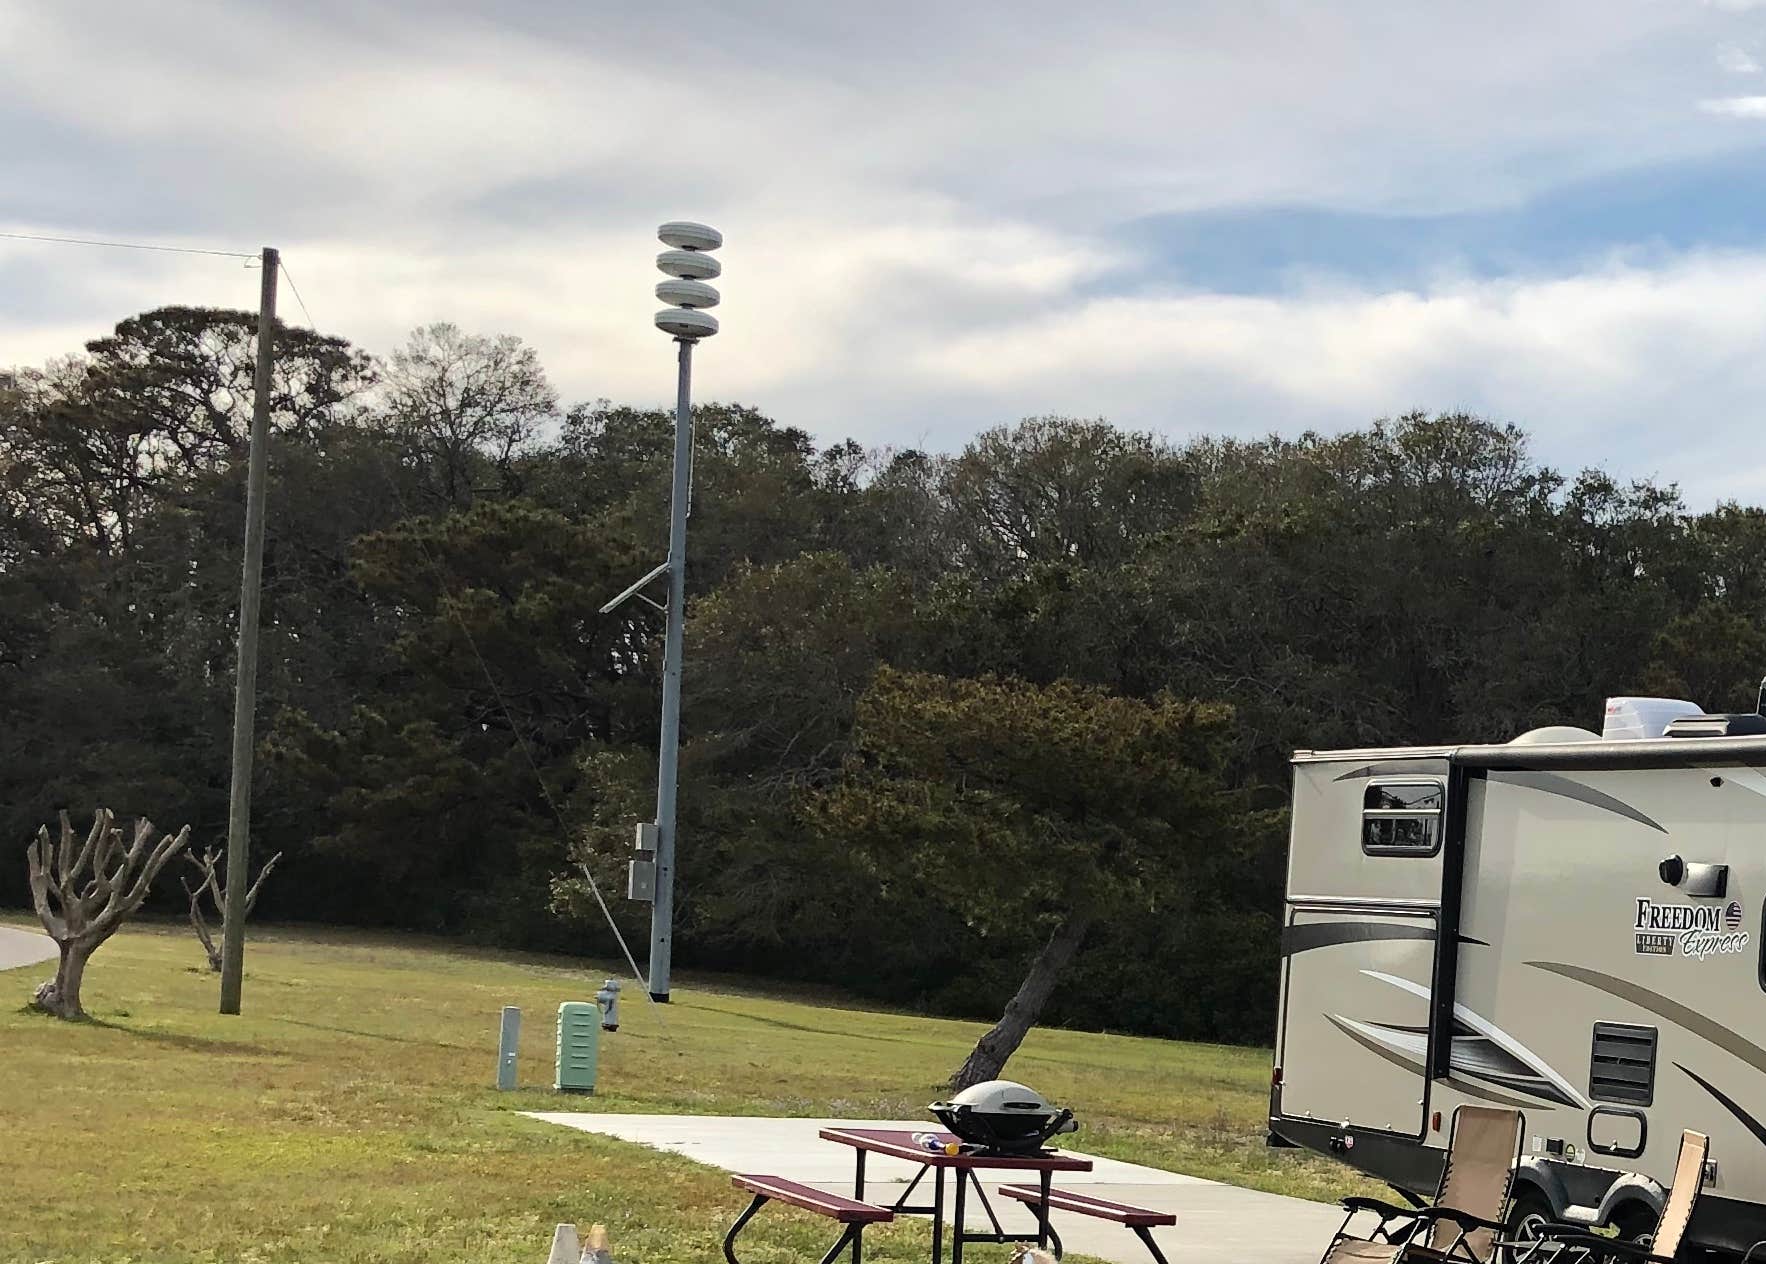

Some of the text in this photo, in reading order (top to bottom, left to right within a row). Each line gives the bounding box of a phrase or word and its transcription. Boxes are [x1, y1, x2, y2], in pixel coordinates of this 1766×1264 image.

[1635, 898, 1721, 932] FREEDOM
[1637, 935, 1673, 947] LIBERTY
[1679, 929, 1748, 958] Express
